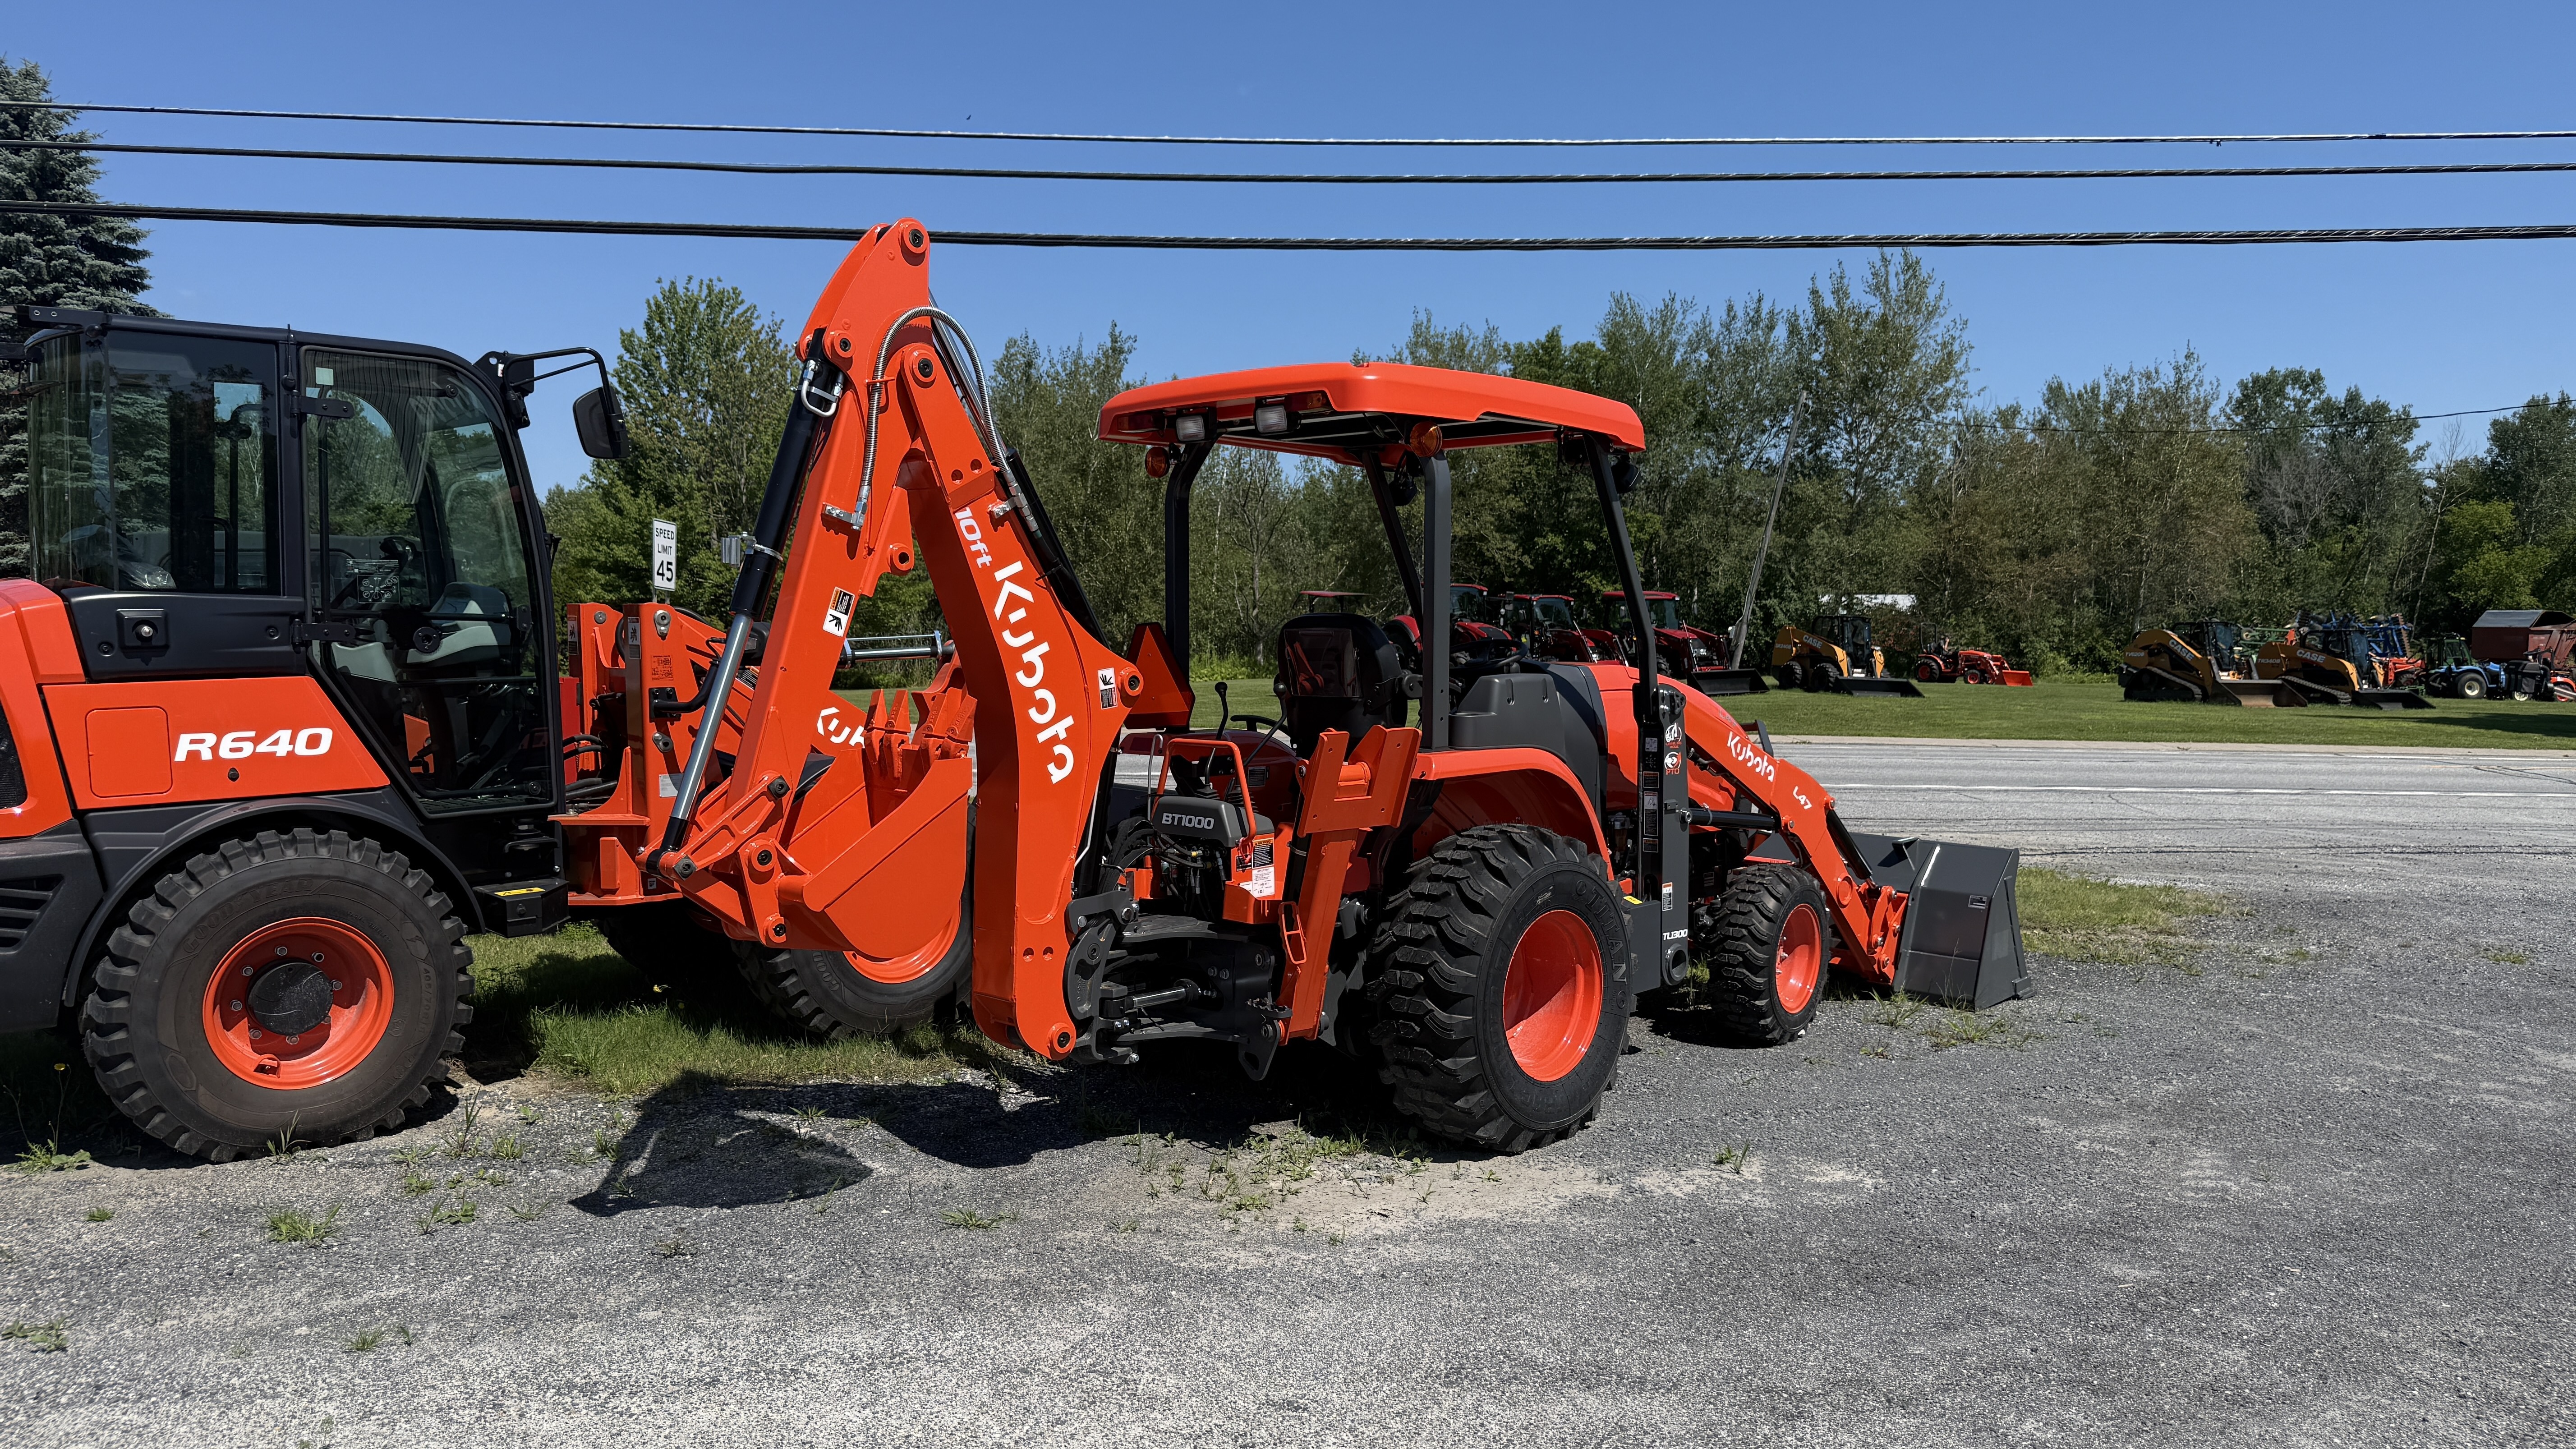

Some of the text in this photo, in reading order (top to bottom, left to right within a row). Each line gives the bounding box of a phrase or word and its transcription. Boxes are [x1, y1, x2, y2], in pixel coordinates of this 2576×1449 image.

[655, 527, 675, 540] SPEED
[955, 506, 993, 569] 10ft
[658, 543, 672, 556] LIMIT
[656, 560, 673, 582] 45
[1803, 635, 1823, 649] CASE
[2169, 639, 2194, 661] CASE
[2296, 649, 2326, 663] CASE
[994, 560, 1074, 785] Kubota
[174, 727, 333, 762] R640
[1727, 731, 1775, 783] Kubota
[1792, 786, 1812, 810] L47
[1162, 813, 1214, 829] BT1000
[183, 878, 315, 953] GOODYEAR
[1585, 886, 1628, 986] TITAN
